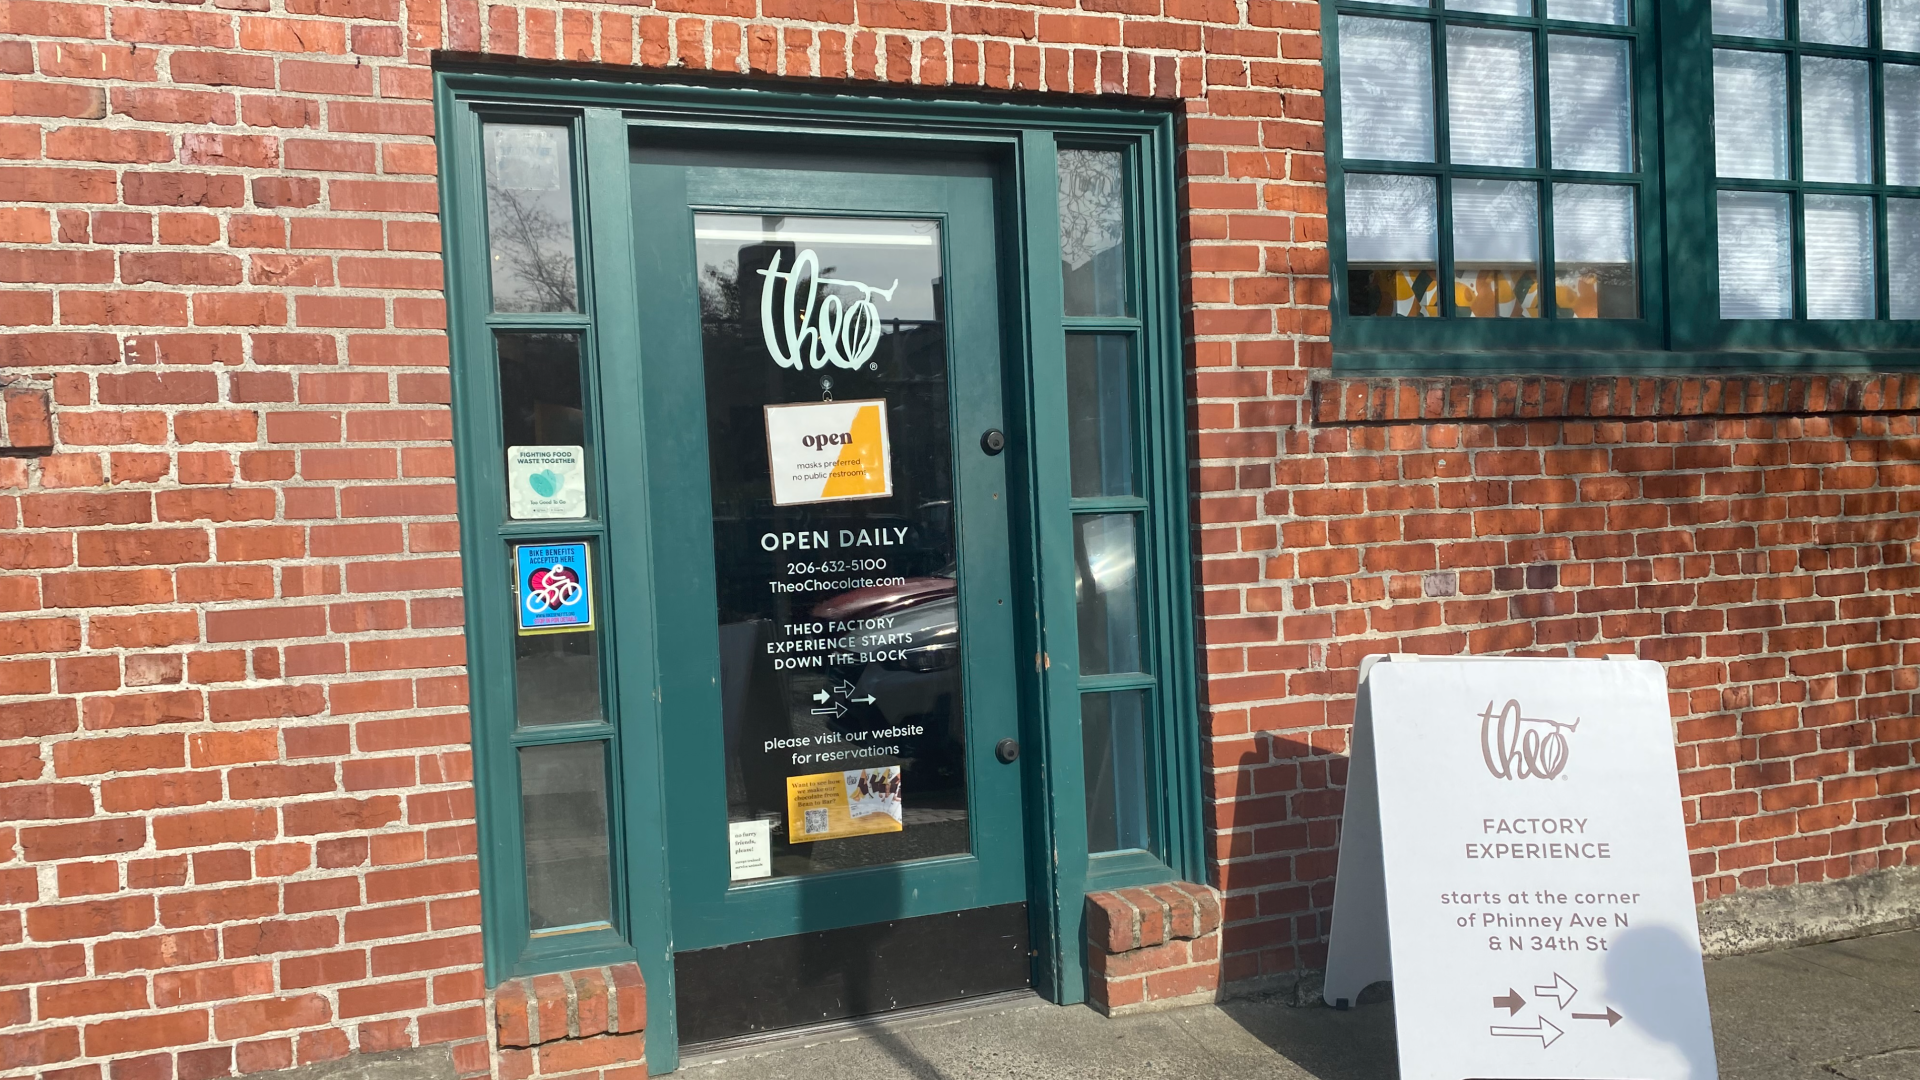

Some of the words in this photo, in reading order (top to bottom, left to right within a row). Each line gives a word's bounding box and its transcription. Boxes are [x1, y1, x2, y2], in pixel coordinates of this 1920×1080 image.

[756, 249, 898, 370] theo
[802, 432, 853, 451] open
[796, 461, 822, 469] masks
[824, 458, 860, 468] preferred
[804, 472, 828, 481] public
[829, 470, 866, 478] restrooms
[760, 530, 829, 552] OPEN
[839, 526, 908, 548] DAILY
[545, 548, 575, 556] BENEFITS
[787, 558, 887, 575] 206-632-5100
[769, 576, 906, 594] TheoChocolate.com
[784, 622, 823, 636] THEO
[828, 617, 894, 632] FACTORY
[767, 636, 856, 654] EXPERIENCE
[861, 632, 913, 646] STARTS
[774, 656, 822, 670] DOWN
[828, 653, 854, 666] THE
[860, 649, 908, 663] BLOCK
[764, 736, 810, 752] please
[814, 732, 841, 745] visit
[845, 730, 868, 742] our
[872, 724, 924, 739] website
[1476, 698, 1580, 780] theo
[792, 752, 812, 765] for
[815, 744, 900, 762] reservations
[1482, 818, 1588, 834] FACTORY
[1465, 842, 1611, 859] EXPERIENCE
[1440, 891, 1501, 904] starts
[1508, 891, 1530, 904] at
[1535, 890, 1568, 904] the
[1574, 893, 1640, 904] corner
[1456, 912, 1476, 928] of
[1482, 912, 1563, 932] Phinney
[1569, 912, 1607, 928] Ave
[1614, 912, 1629, 928] N
[1488, 936, 1501, 950] &
[1510, 936, 1523, 950] N
[1530, 936, 1578, 950] 34th
[1586, 936, 1608, 950] St
